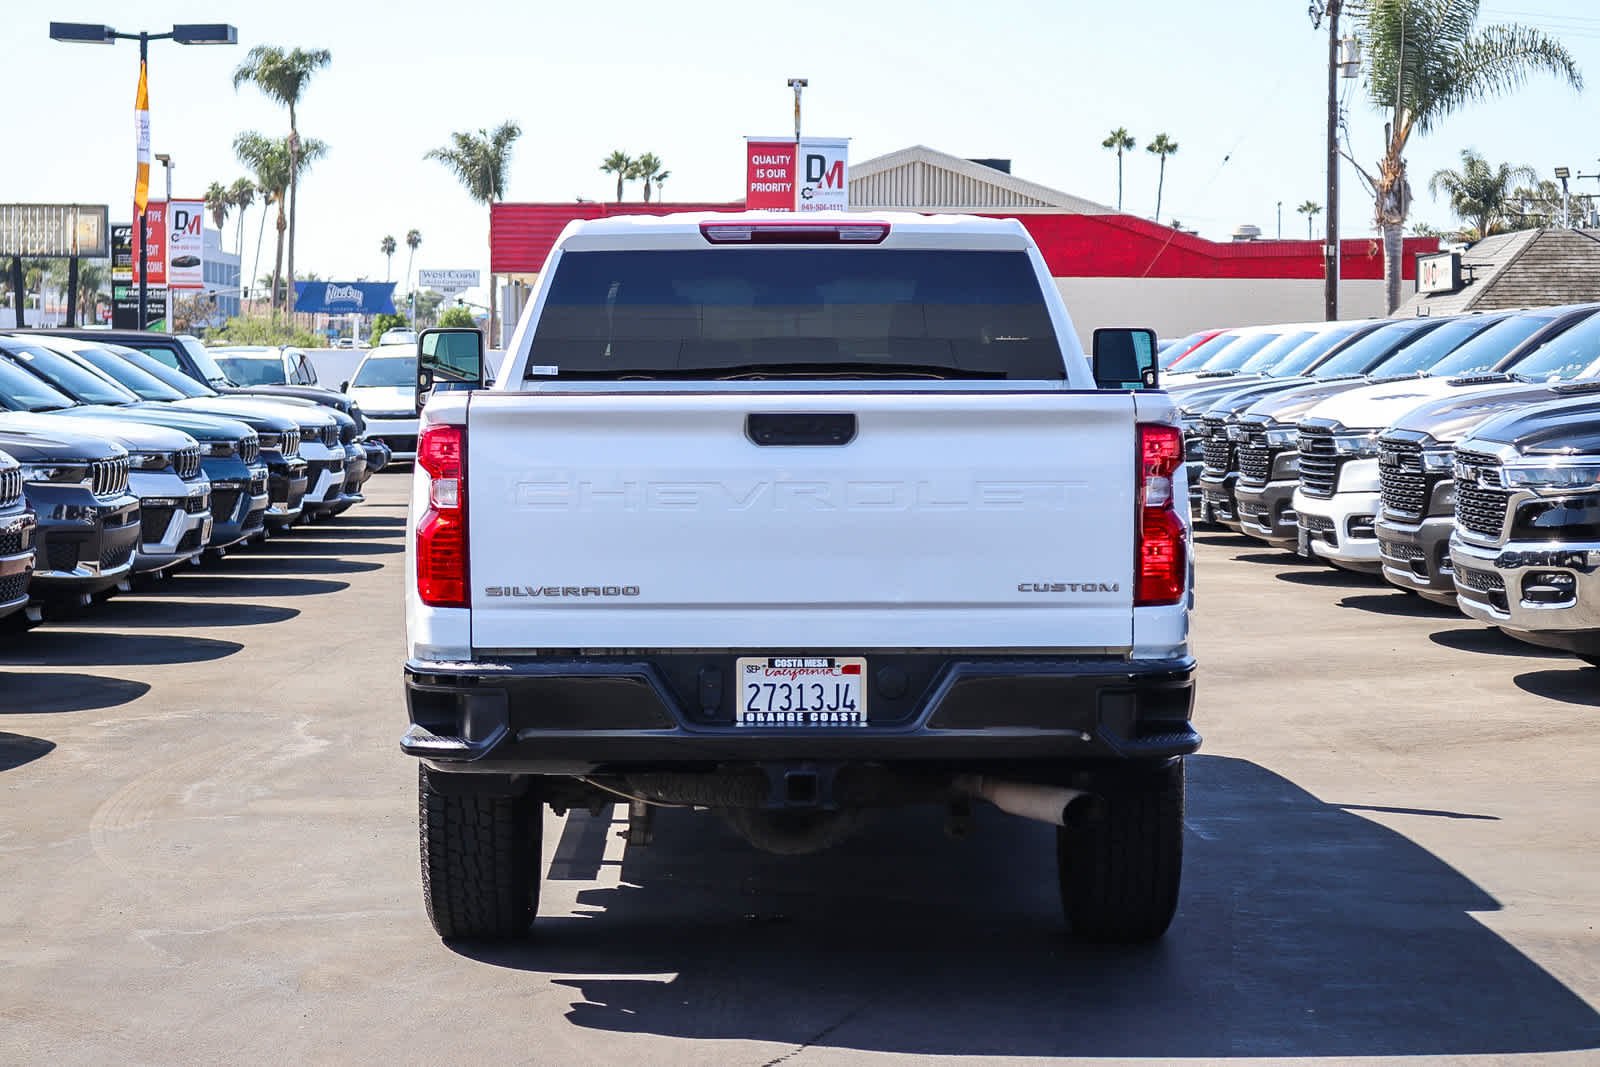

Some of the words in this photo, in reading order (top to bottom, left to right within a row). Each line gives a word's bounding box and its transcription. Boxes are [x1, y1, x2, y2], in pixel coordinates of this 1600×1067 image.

[752, 155, 791, 165] QUALITY
[756, 169, 765, 178] IS
[767, 169, 786, 178] OUR
[806, 154, 844, 189] DM
[751, 183, 792, 192] PRIORITY
[175, 210, 201, 235] DM
[511, 481, 1089, 512] CHEVROLET
[485, 585, 640, 597] SILVERADO
[1017, 583, 1120, 593] CUSTOM
[774, 659, 802, 668] COSTA
[804, 659, 829, 668] MESA
[746, 665, 760, 673] SEP
[764, 668, 836, 681] California
[747, 683, 857, 712] 27313J4
[746, 712, 804, 721] ORANGE
[810, 712, 859, 721] COAST
